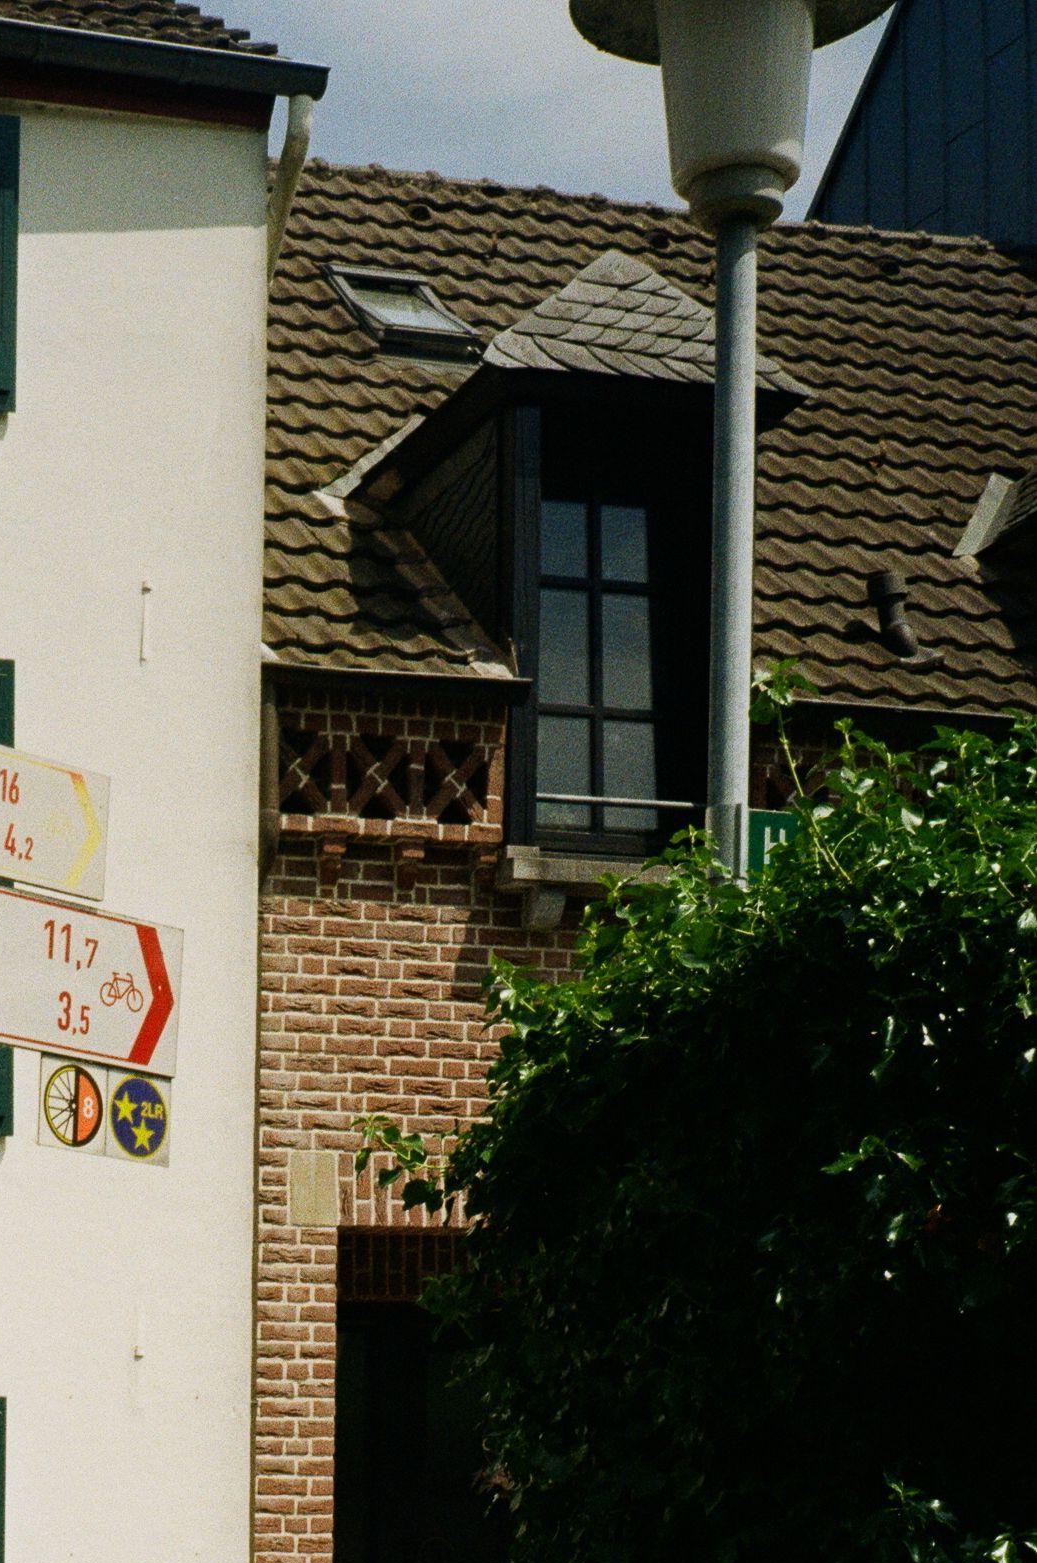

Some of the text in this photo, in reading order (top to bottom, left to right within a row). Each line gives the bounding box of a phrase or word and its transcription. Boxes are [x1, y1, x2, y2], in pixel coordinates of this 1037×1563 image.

[0, 768, 20, 805] 16
[4, 822, 34, 861] 4,2
[44, 919, 99, 971] 11,7
[57, 991, 91, 1036] 3,5
[82, 1096, 95, 1119] 8
